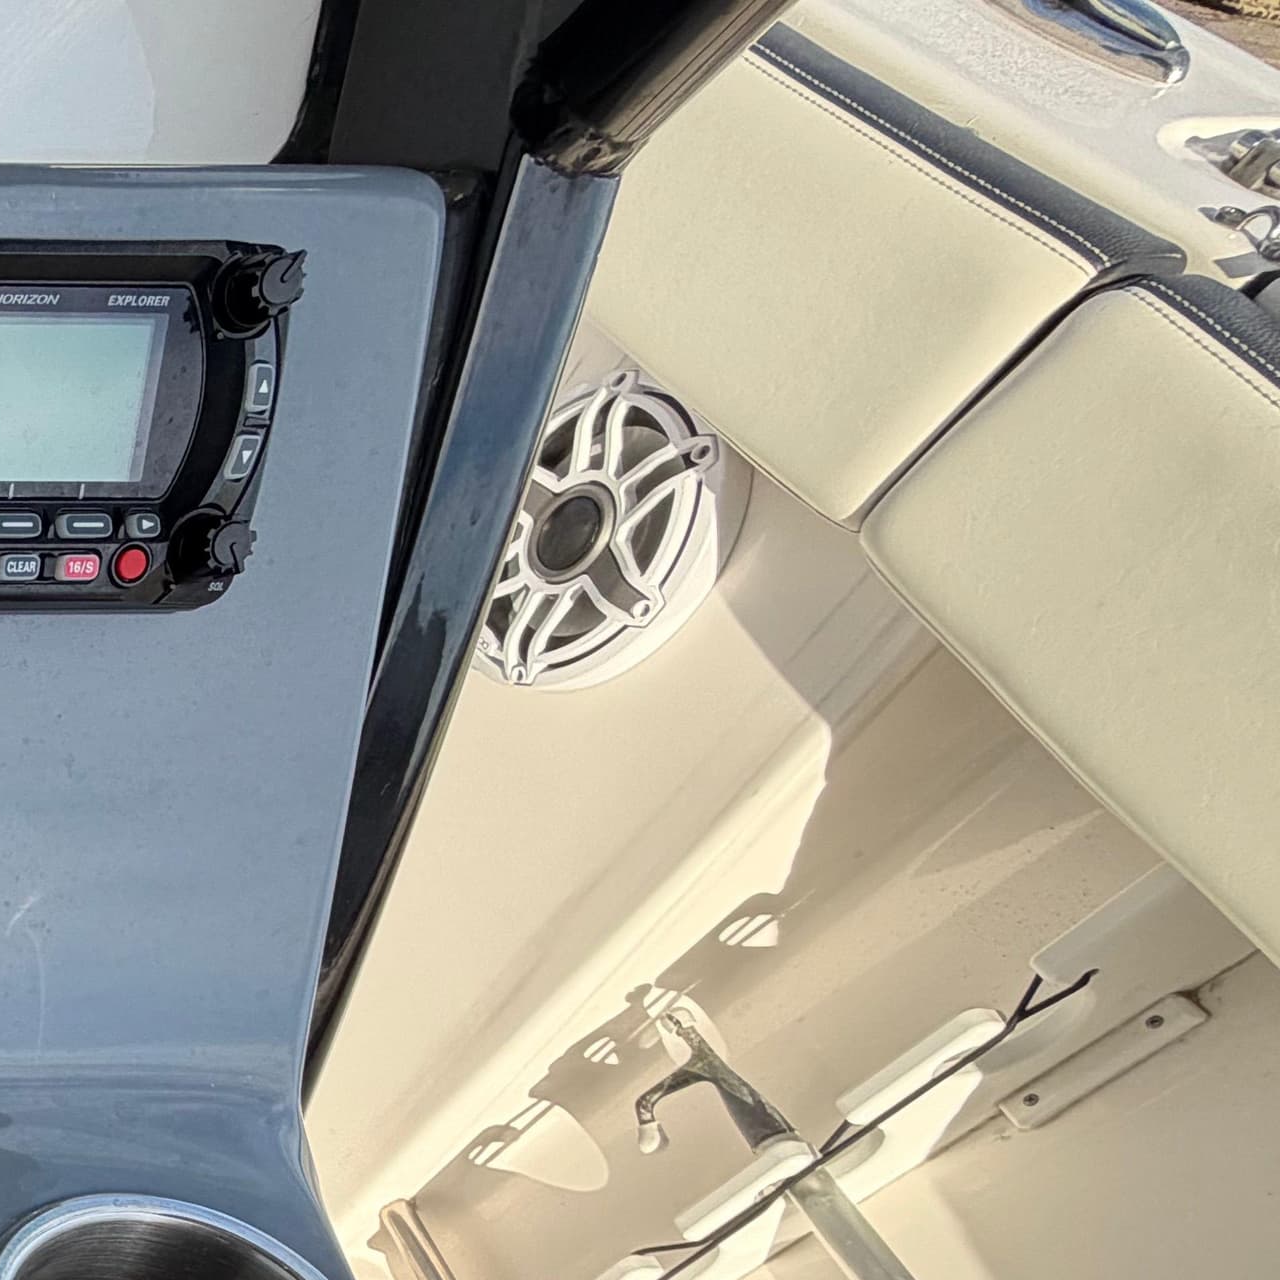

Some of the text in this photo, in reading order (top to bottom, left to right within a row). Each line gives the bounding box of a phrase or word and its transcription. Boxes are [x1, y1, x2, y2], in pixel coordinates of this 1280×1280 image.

[107, 294, 170, 307] EXPLORER
[6, 561, 37, 573] CLEAR
[68, 560, 94, 574] 16/S
